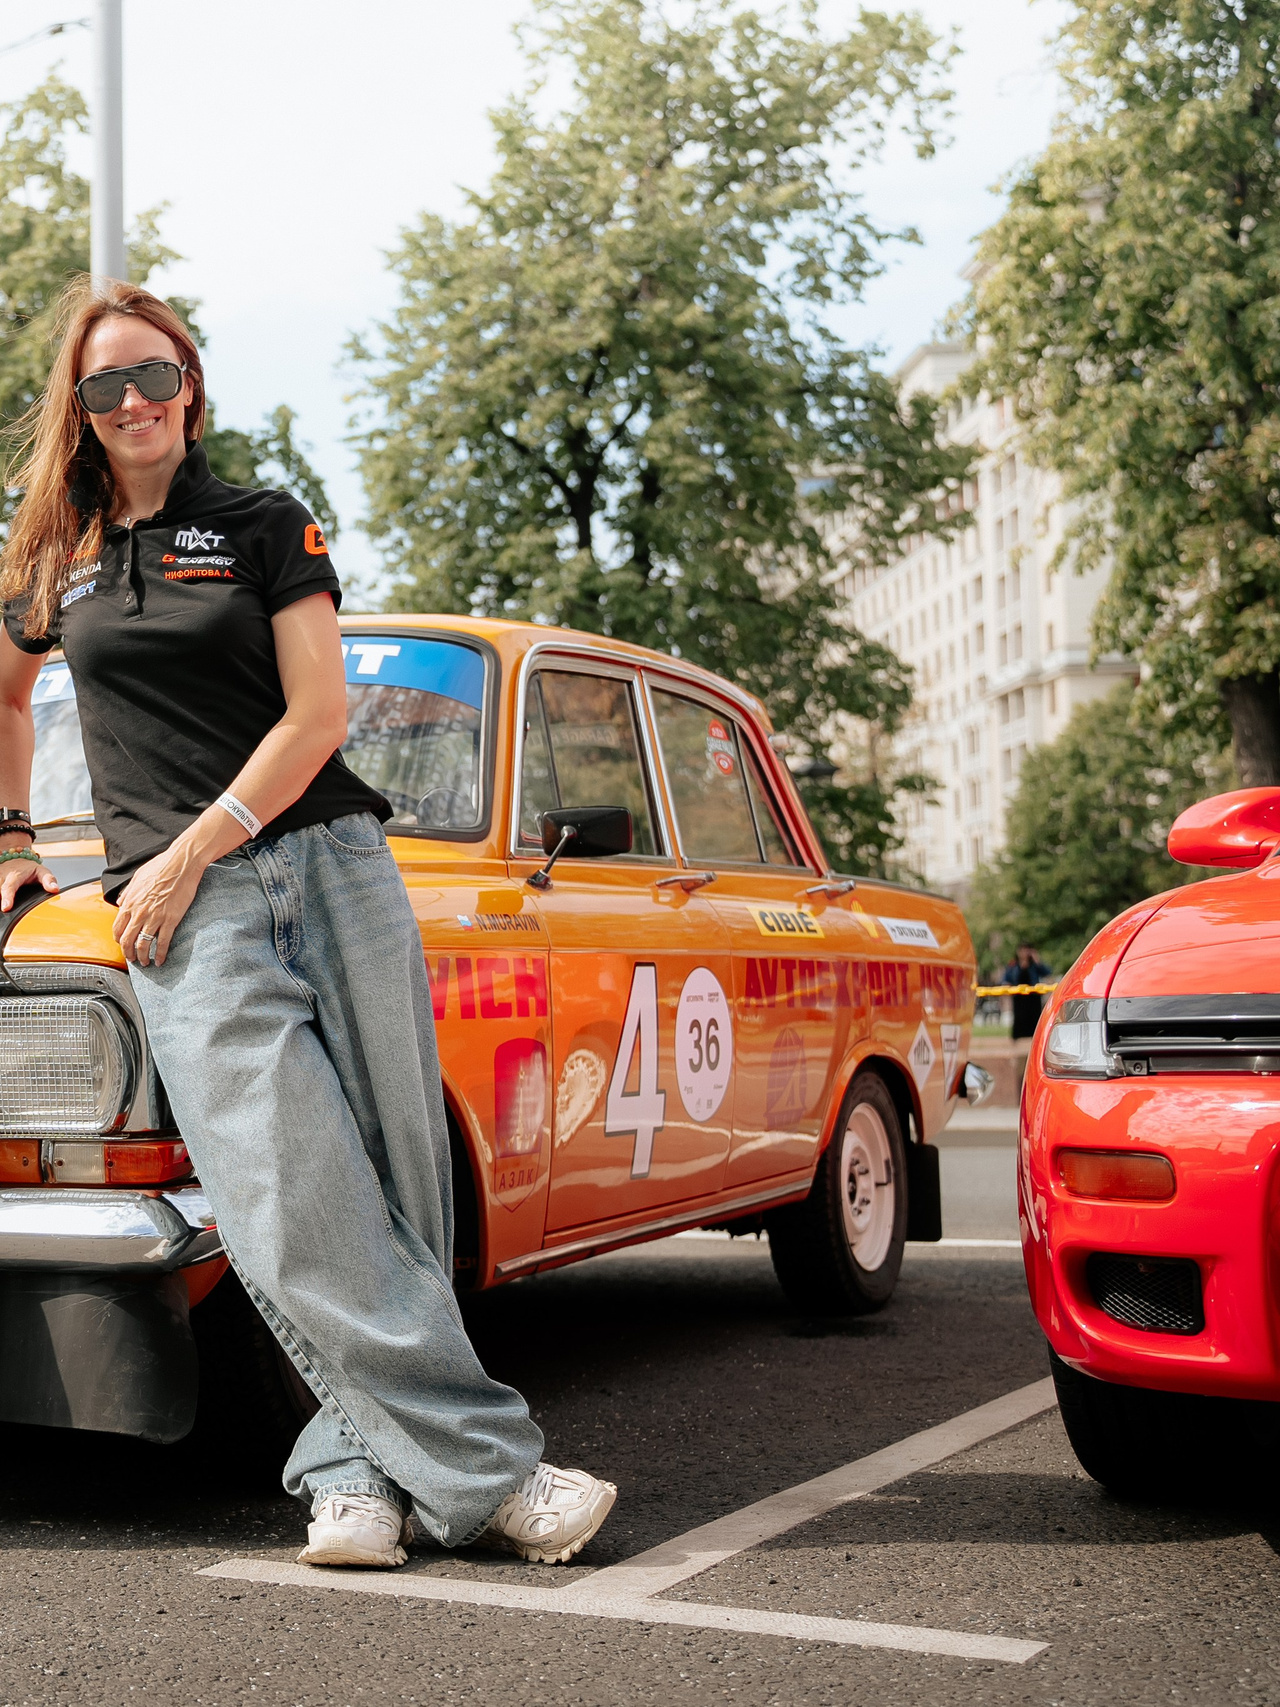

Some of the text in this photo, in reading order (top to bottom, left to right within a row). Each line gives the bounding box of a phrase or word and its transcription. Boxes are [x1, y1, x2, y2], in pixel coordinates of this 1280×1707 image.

[175, 526, 225, 551] MXT
[69, 561, 101, 582] KENDA
[164, 568, 221, 580] НИФОНТОВА
[474, 913, 541, 931] N.MURAVIN
[688, 1017, 721, 1074] 36
[604, 962, 666, 1180] 4
[499, 1168, 534, 1190] АЗЛК
